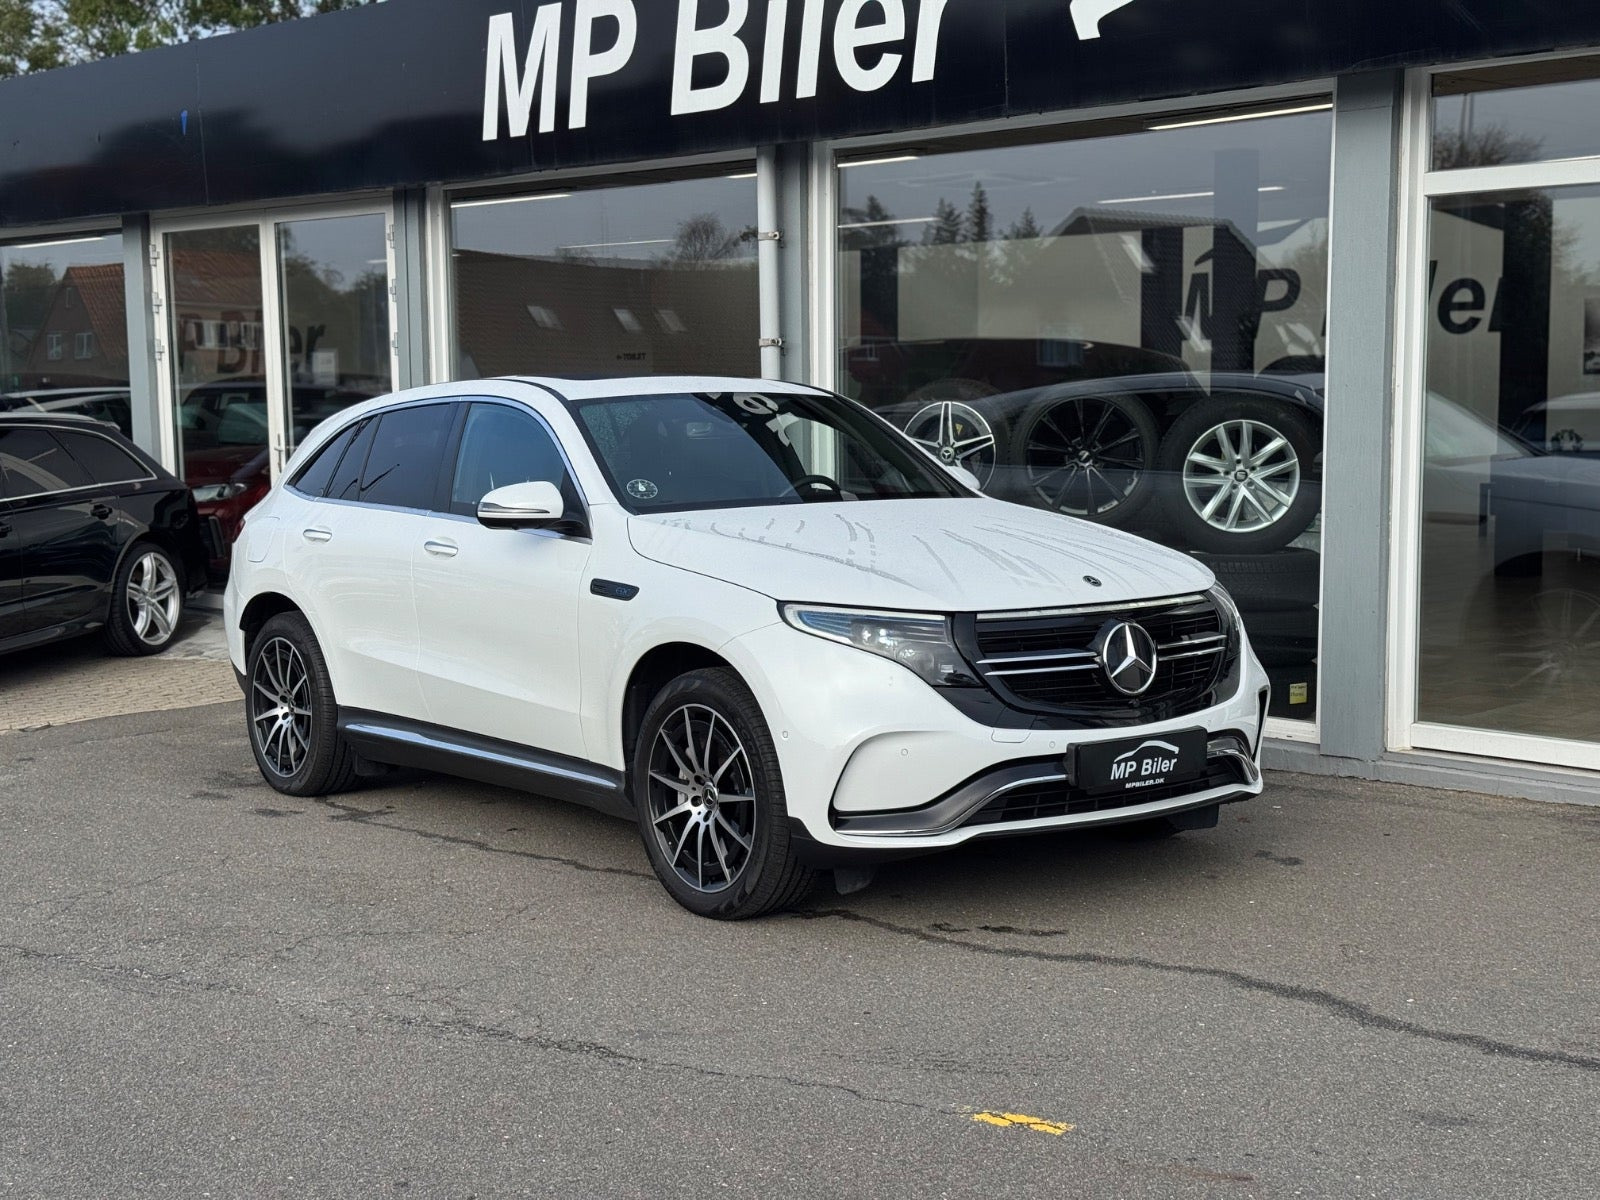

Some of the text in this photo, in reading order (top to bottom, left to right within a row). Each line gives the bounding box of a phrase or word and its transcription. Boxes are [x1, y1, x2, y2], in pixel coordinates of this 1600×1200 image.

[482, 0, 638, 141] MP
[1111, 757, 1177, 779] MP Biler
[1125, 778, 1164, 788] MPBILER.DK
